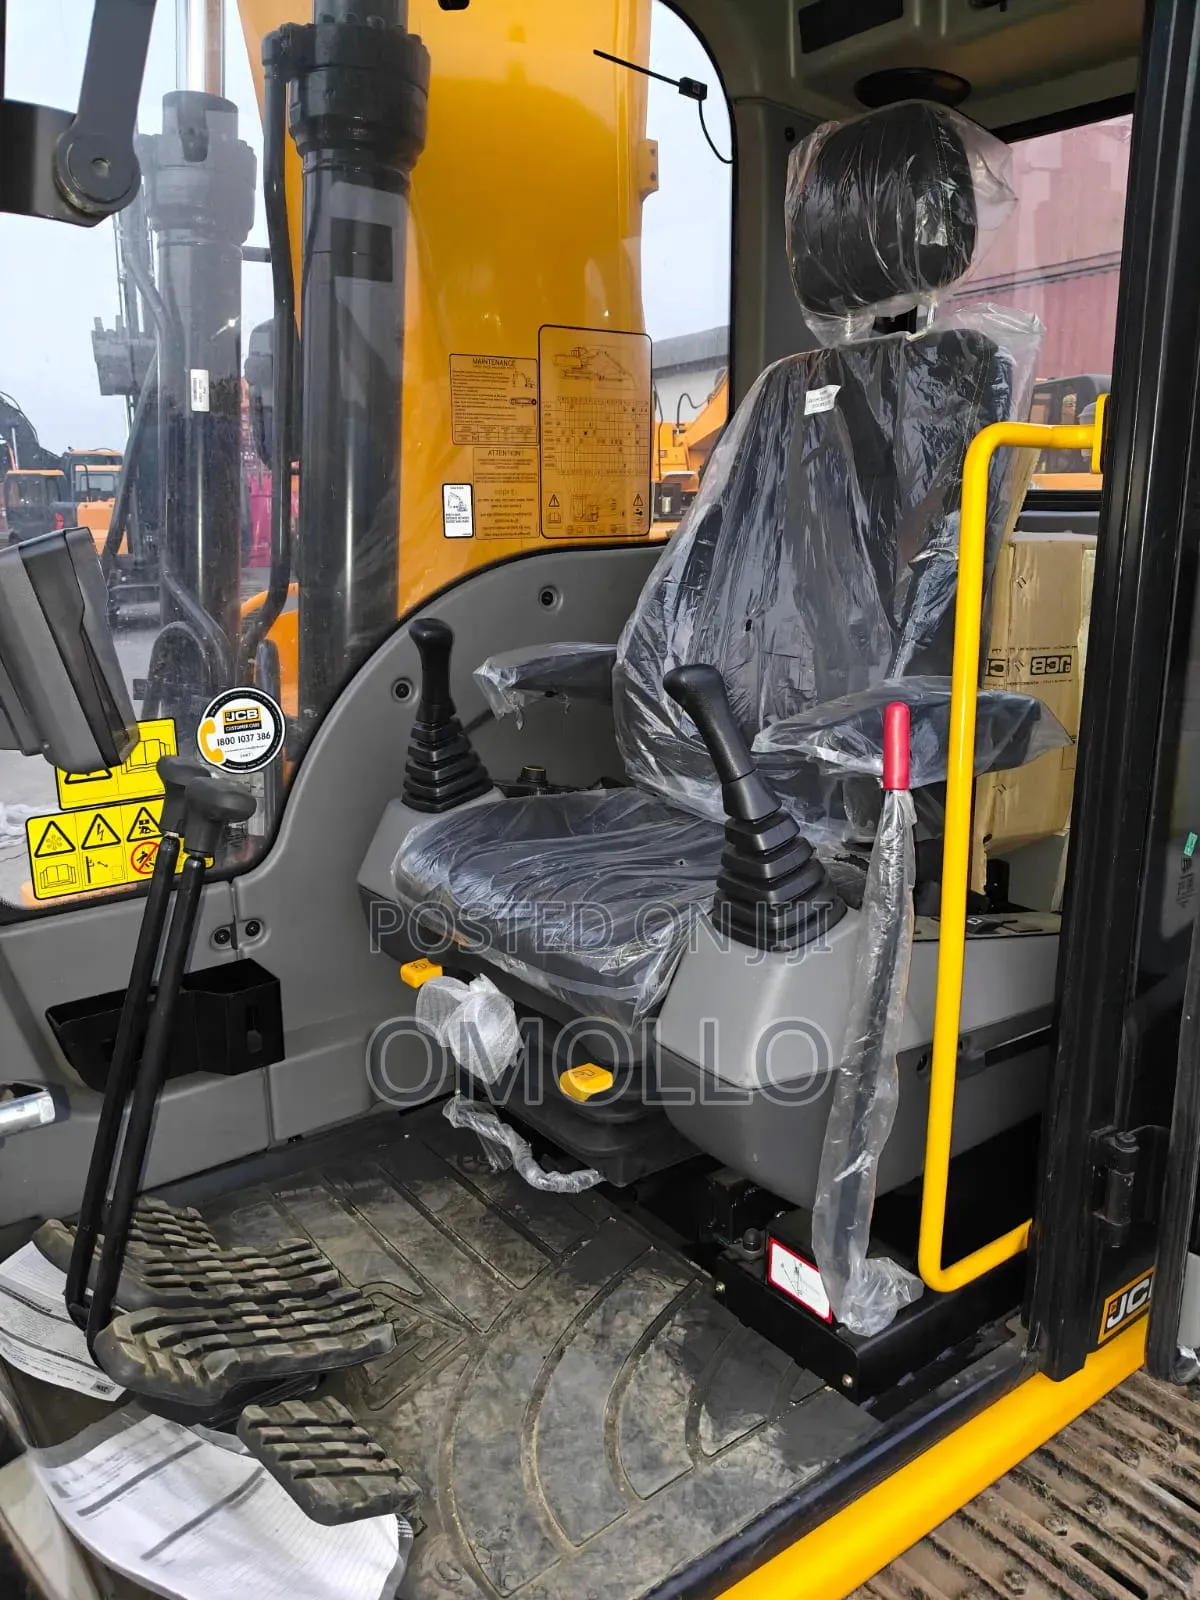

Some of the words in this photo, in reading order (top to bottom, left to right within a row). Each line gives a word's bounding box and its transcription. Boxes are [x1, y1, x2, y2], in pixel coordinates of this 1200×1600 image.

[472, 358, 516, 367] MAINTENANCE
[1031, 656, 1071, 675] JCB
[225, 709, 258, 722] JCB
[216, 736, 236, 746] 1800
[238, 734, 255, 744] 1037
[256, 731, 271, 741] 386
[1107, 1273, 1154, 1329] JC
